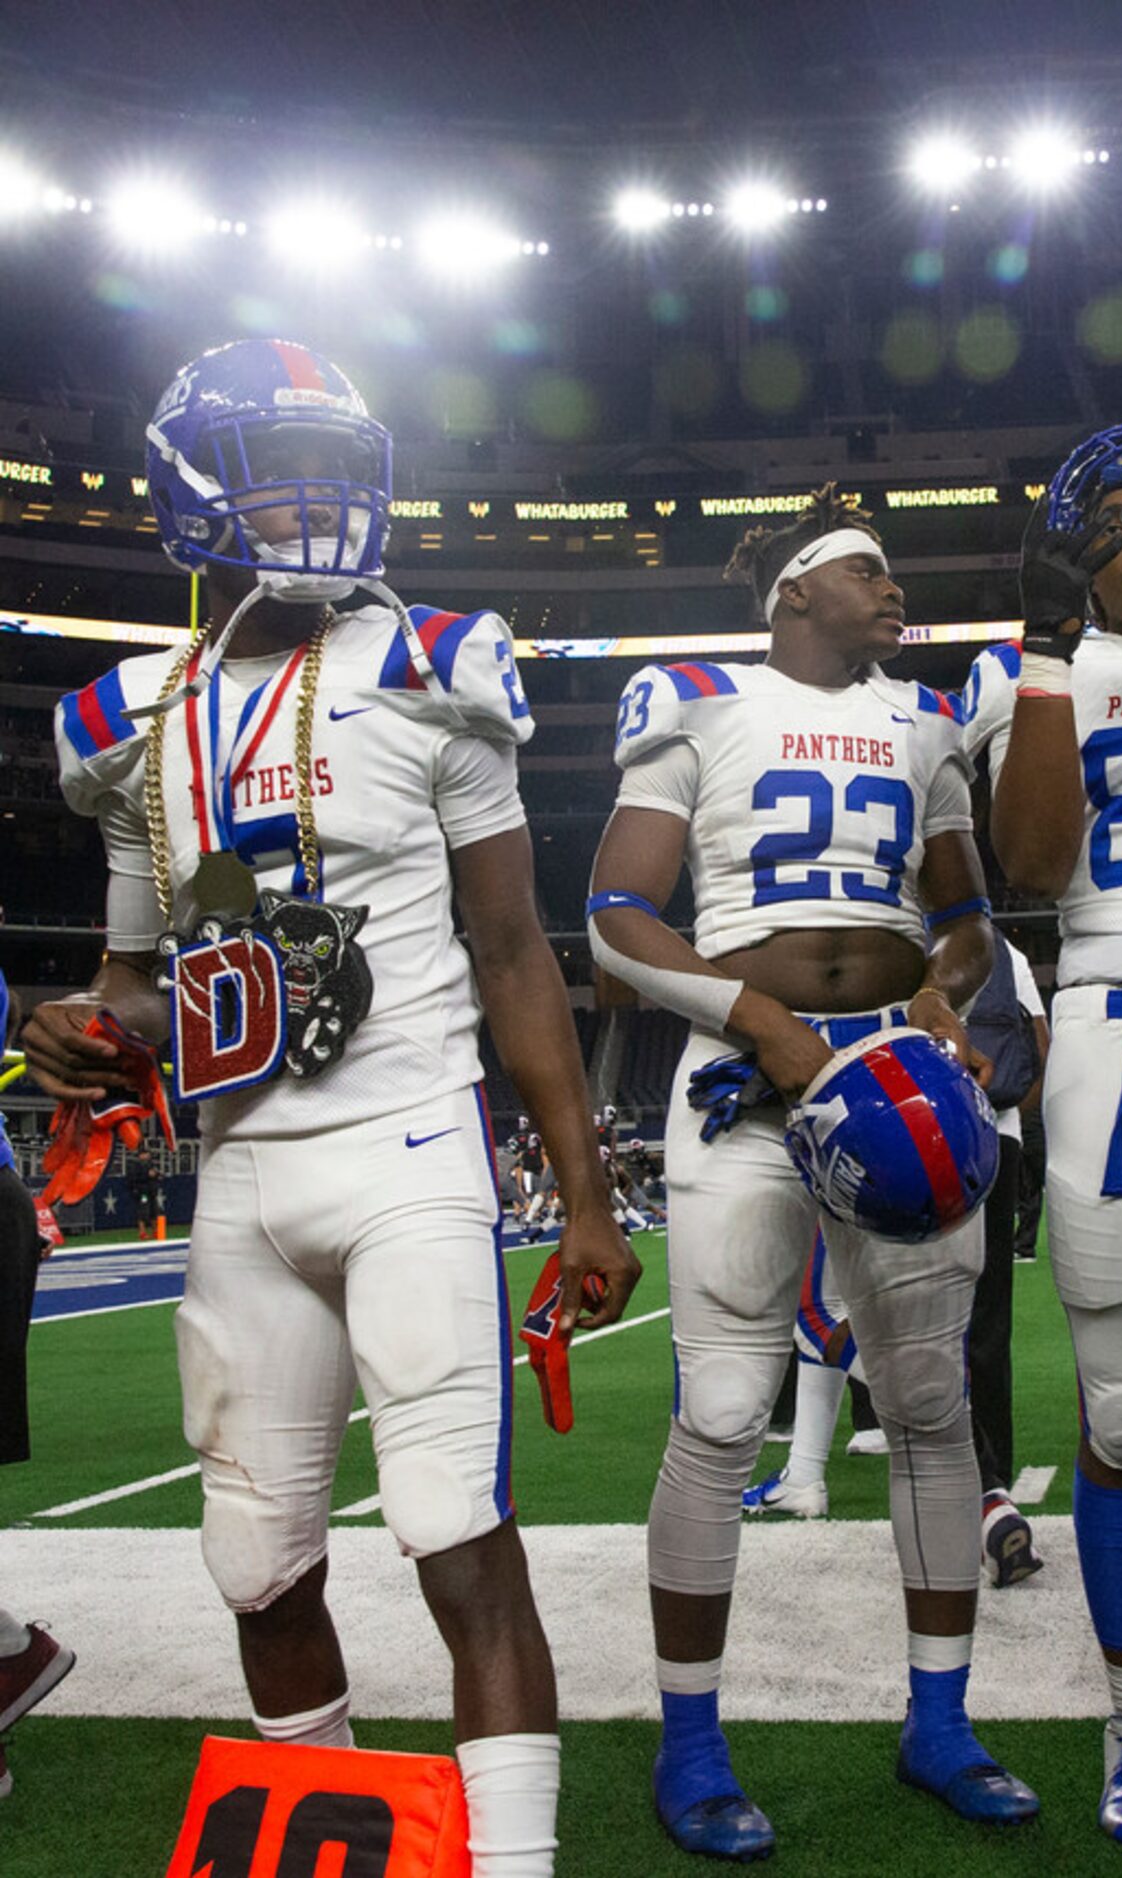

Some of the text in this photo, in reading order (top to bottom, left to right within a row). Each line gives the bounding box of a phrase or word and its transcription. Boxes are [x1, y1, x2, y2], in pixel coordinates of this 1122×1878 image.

[515, 502, 629, 520] WHATABURGER
[701, 495, 815, 516] WHATABURGER
[886, 486, 999, 508] WHATABURGER
[780, 733, 895, 768] PANTHERS
[749, 769, 914, 907] 23
[169, 932, 288, 1100] D
